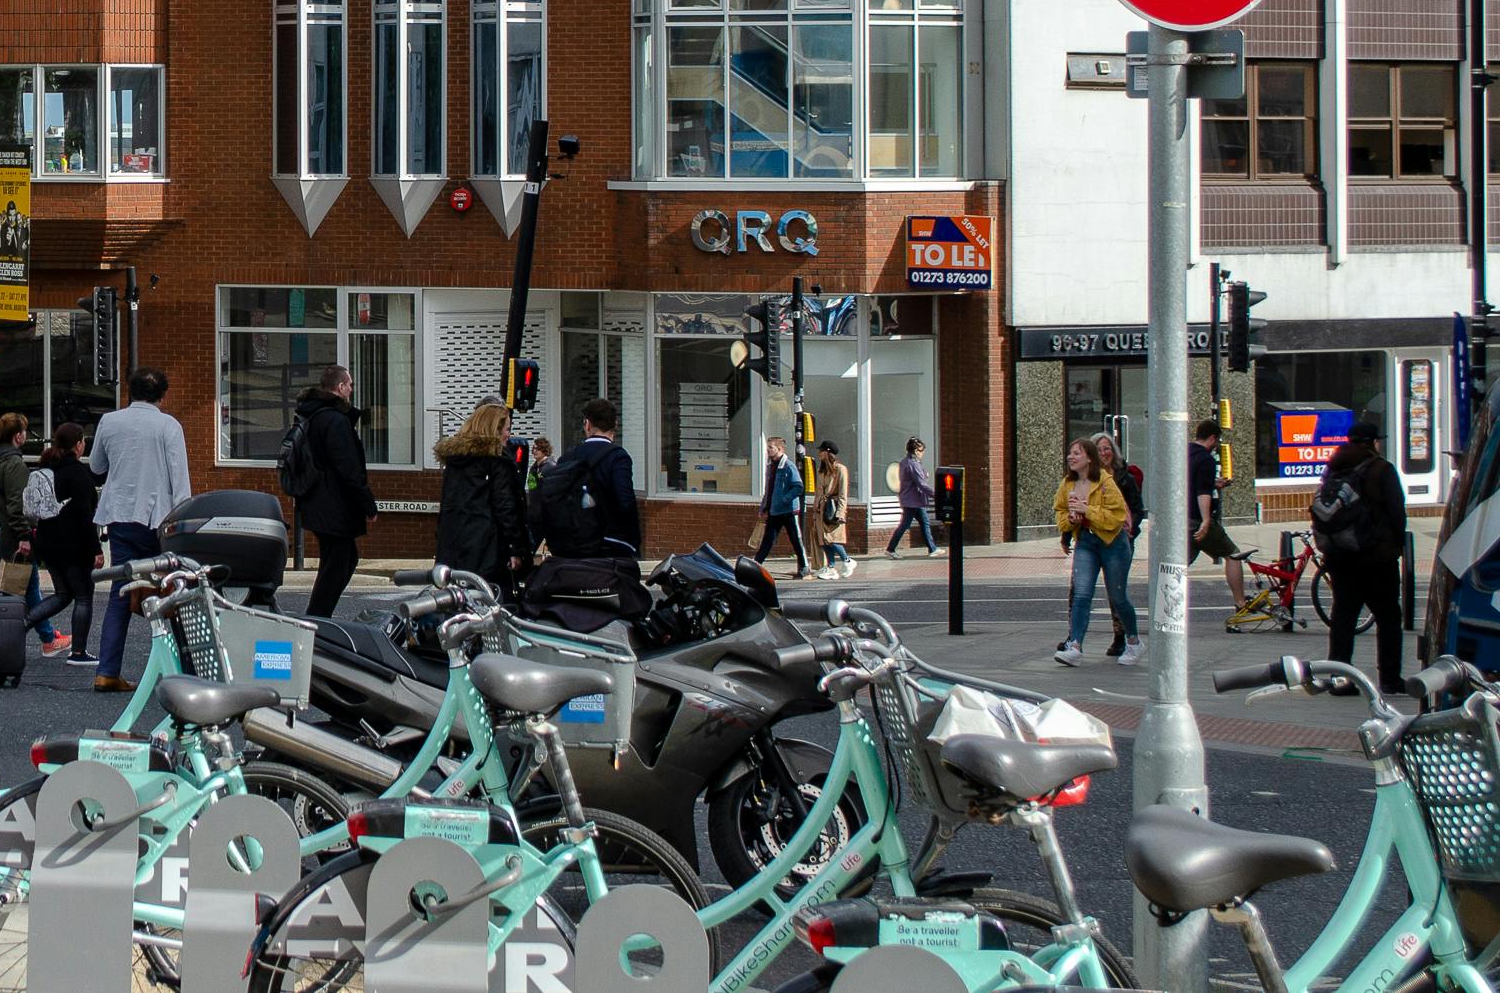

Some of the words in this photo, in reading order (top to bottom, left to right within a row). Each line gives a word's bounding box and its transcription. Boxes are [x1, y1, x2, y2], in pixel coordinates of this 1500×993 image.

[691, 209, 820, 255] QRQ
[961, 217, 977, 237] 50%
[975, 234, 989, 249] LET
[912, 244, 945, 266] TO
[911, 271, 944, 283] 01273
[946, 272, 989, 285] 876200
[1052, 333, 1099, 351] 96-97
[1187, 331, 1229, 348] ROD
[1293, 433, 1312, 442] SHW
[1298, 448, 1314, 460] TO
[1317, 448, 1334, 460] LET
[1284, 465, 1313, 475] 01273
[403, 503, 428, 511] ROAD
[254, 652, 291, 662] AMERICAN
[261, 661, 292, 669] EXPRESS
[569, 702, 605, 711] EXPRESS
[444, 831, 471, 841] tourist
[841, 853, 861, 872] Life
[898, 925, 910, 935] Be
[912, 927, 918, 935] a
[921, 925, 960, 936] traveller
[926, 938, 957, 947] tourist
[1395, 934, 1418, 958] Life
